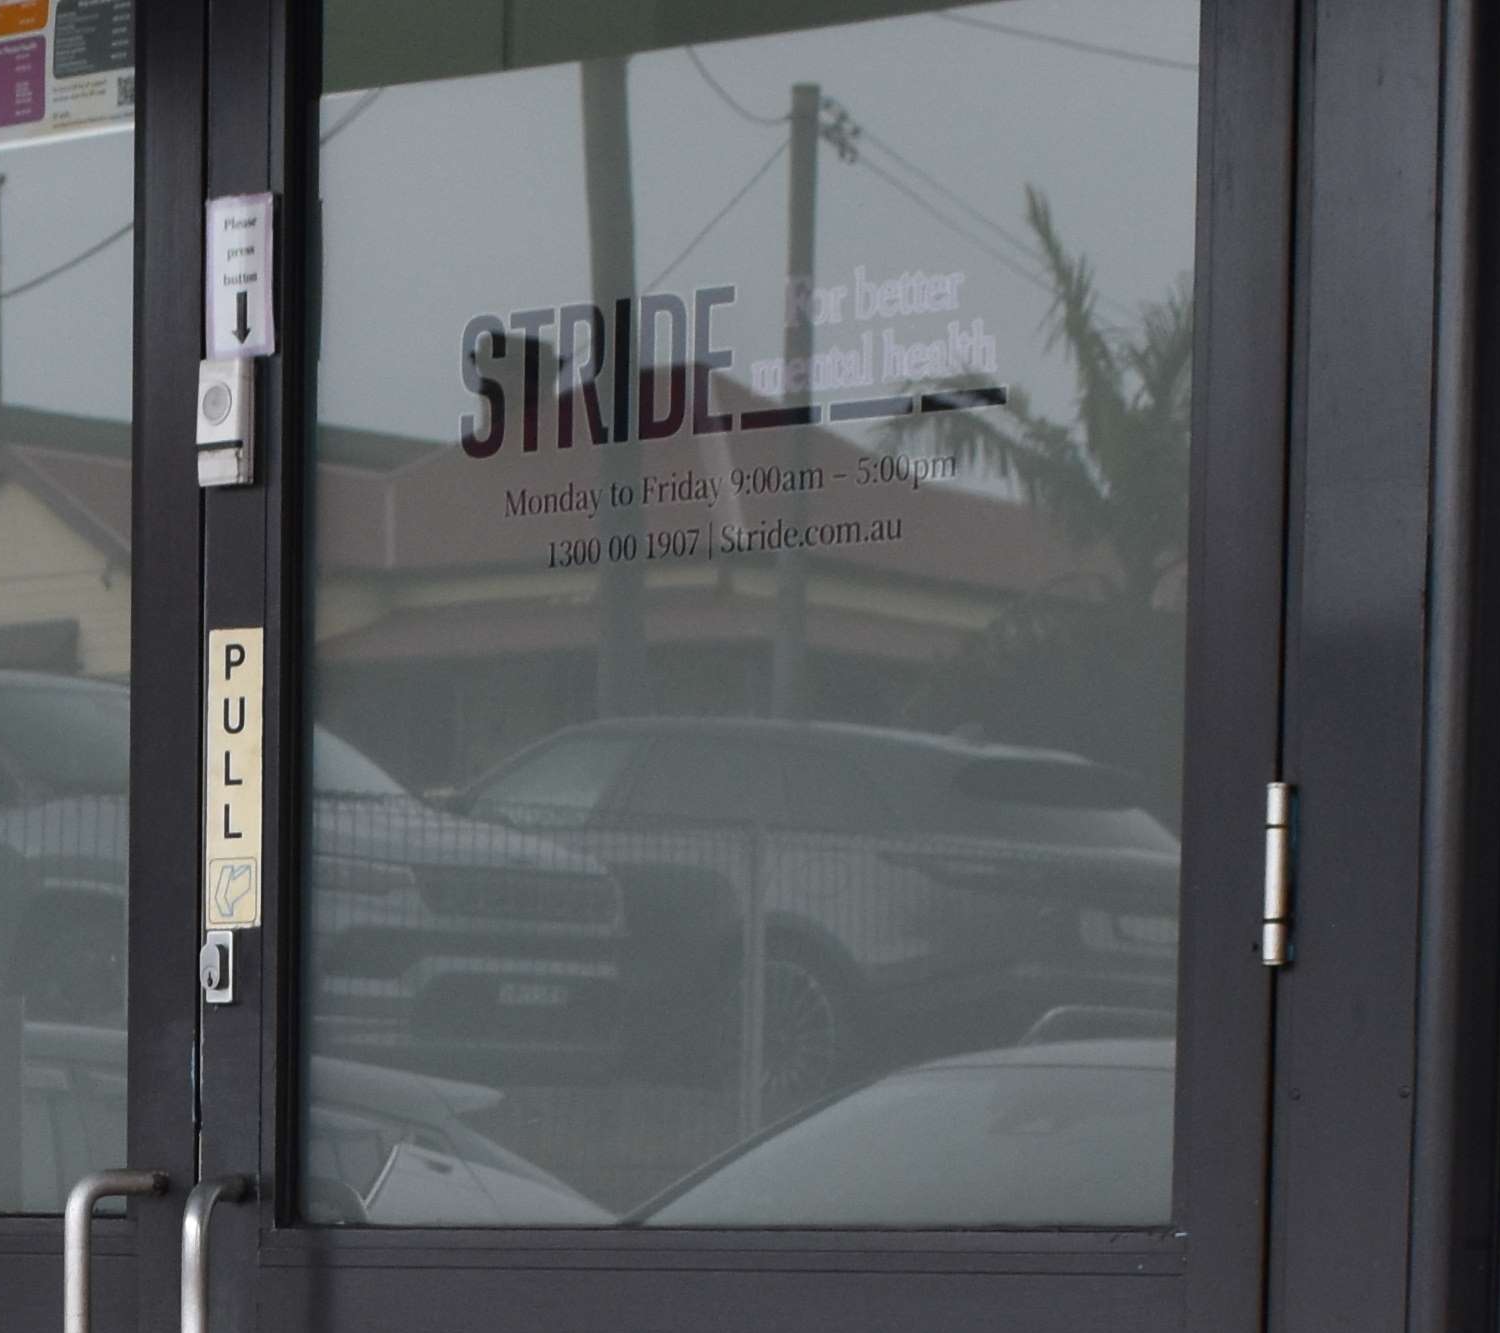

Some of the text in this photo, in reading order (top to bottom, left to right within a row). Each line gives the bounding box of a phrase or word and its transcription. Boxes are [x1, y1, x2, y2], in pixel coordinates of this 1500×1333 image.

[224, 216, 257, 231] Please
[223, 273, 257, 286] button
[854, 264, 964, 321] better
[460, 286, 736, 459] STRIDE
[751, 317, 998, 396] mental health
[504, 482, 602, 520] Monday
[611, 484, 634, 508] to
[642, 472, 723, 509] Friday
[730, 463, 824, 497] 9:00am
[855, 451, 958, 491] 5:00pm
[546, 535, 602, 568] 1300
[608, 533, 637, 562] 00
[646, 527, 700, 559] 1907
[720, 514, 903, 554] Stride.com.au
[222, 643, 246, 840] PULL
